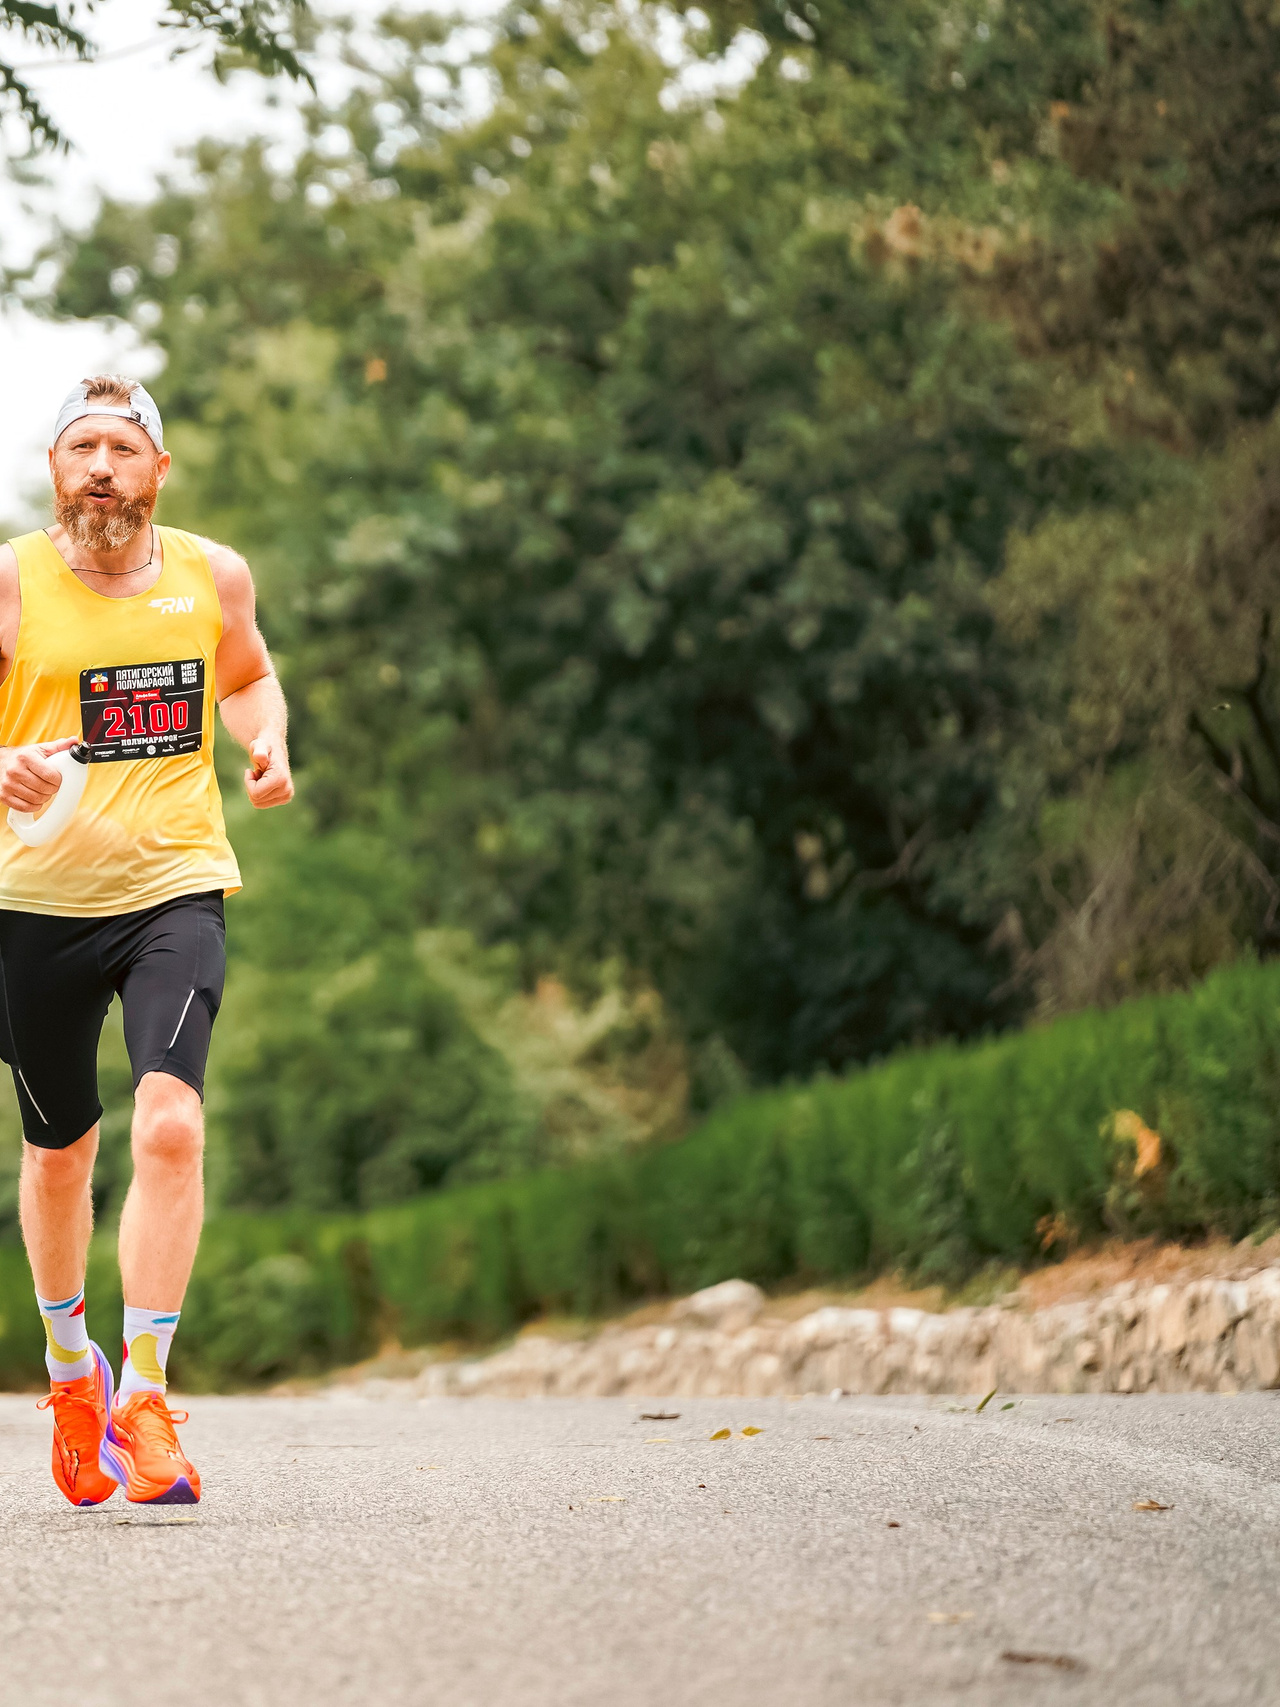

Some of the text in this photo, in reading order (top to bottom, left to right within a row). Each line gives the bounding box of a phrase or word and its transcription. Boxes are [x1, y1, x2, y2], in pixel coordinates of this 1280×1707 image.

[148, 596, 195, 614] RAY
[115, 663, 174, 681] ПЯТИГОРСКИЙ
[116, 675, 175, 691] ПОЛУМАРАФОН
[103, 700, 188, 738] 2100
[121, 735, 178, 746] ПОЛУМАРАФОН
